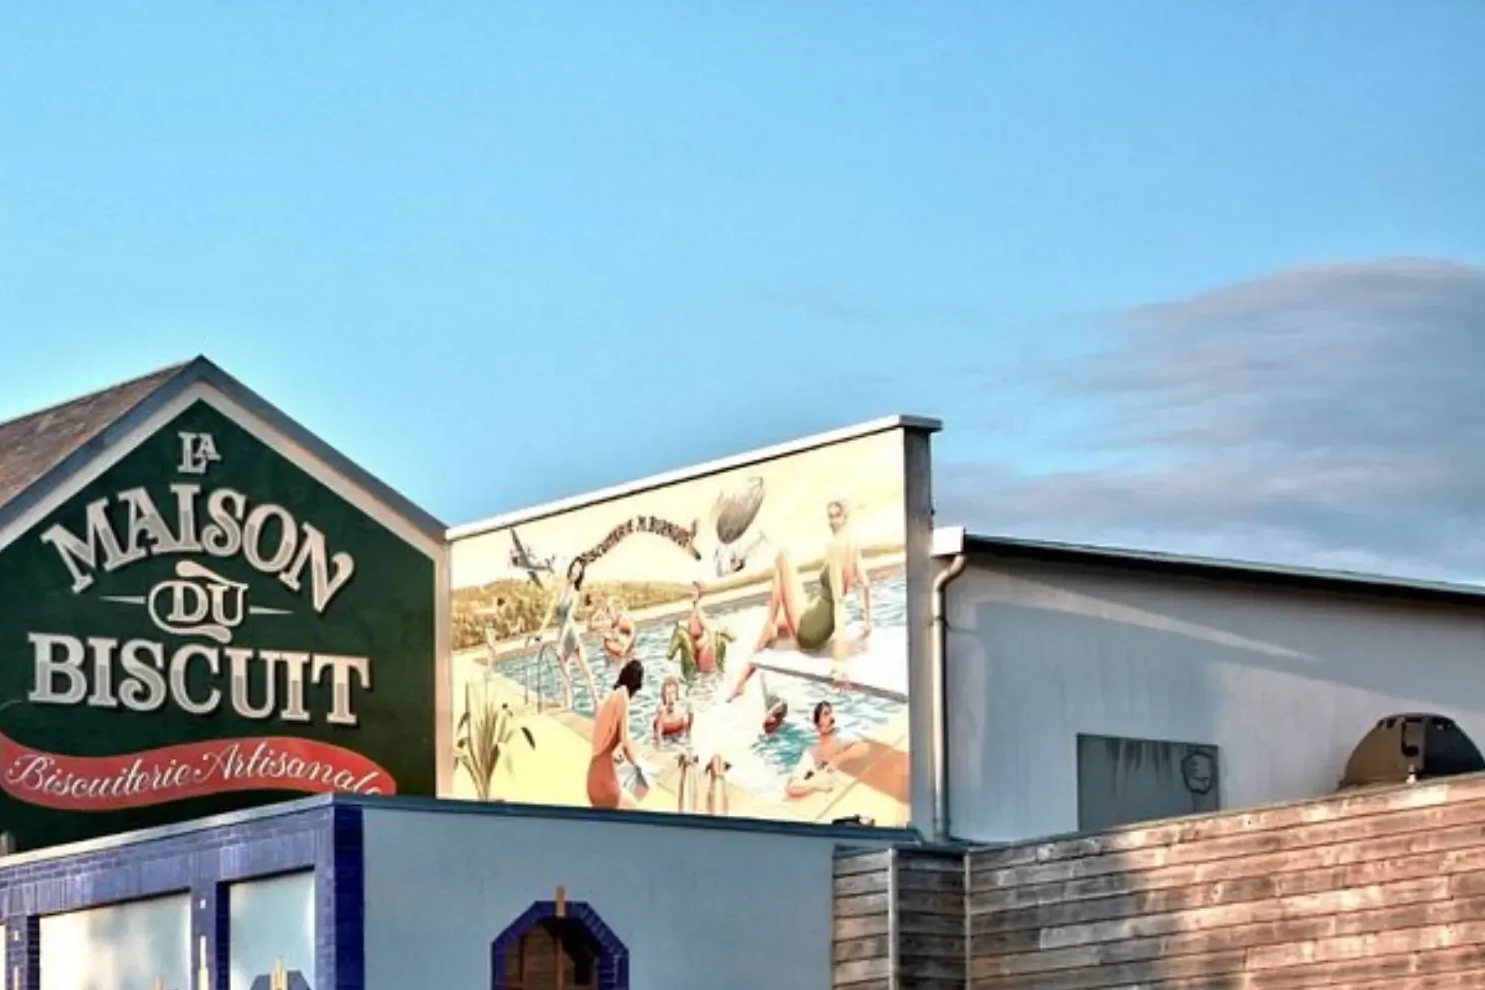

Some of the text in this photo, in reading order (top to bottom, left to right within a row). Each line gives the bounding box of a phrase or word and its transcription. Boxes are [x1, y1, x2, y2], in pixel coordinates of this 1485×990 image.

[177, 431, 221, 474] LA
[41, 483, 355, 613] MAISON
[147, 562, 249, 643] DU
[28, 632, 371, 726] BISCUIT
[6, 753, 192, 800] Biscuiterie
